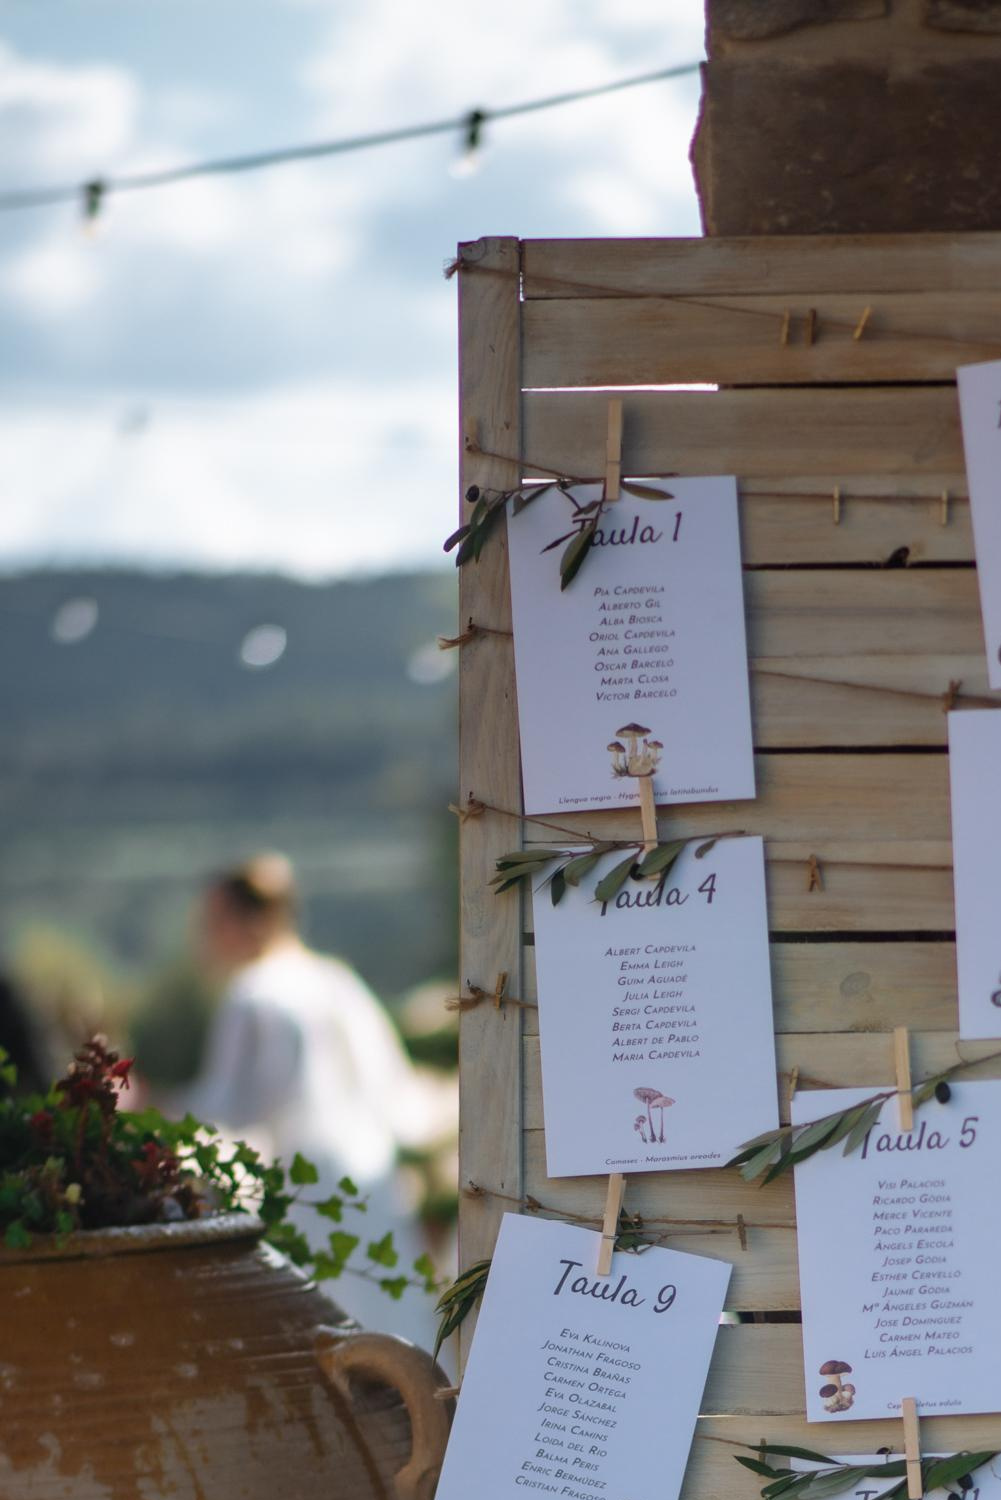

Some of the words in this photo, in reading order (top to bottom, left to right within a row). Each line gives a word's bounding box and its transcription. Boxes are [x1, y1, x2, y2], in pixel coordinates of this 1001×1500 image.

[672, 512, 683, 543] 1
[698, 873, 717, 904] 4
[604, 947, 642, 957] ALBERT
[644, 944, 696, 955] CAPDEVILA
[619, 961, 650, 972] EMMA
[653, 959, 684, 969] LEIGH
[617, 976, 645, 987] GUIM
[622, 991, 649, 1003] JULIA
[653, 989, 684, 1000] LEIGH
[612, 1007, 641, 1017] SERGI
[643, 1005, 696, 1016] CAPDEVILA
[612, 1021, 642, 1033] BERTA
[645, 1019, 698, 1030] CAPDEVILA
[611, 1037, 649, 1048] ALBERT
[651, 1036, 665, 1045] DE
[667, 1033, 700, 1044] PABLO
[612, 1052, 645, 1063] MARIA
[648, 1049, 701, 1061] CAPDEVILA
[861, 1121, 950, 1159] Taula
[959, 1116, 979, 1149] 5
[553, 1259, 646, 1309] Taula
[653, 1283, 677, 1314] 9
[559, 1328, 580, 1341] EVA
[582, 1333, 631, 1353] KALINOVA
[540, 1339, 594, 1360] JONATHAN
[595, 1352, 642, 1372] FRAGOSO
[546, 1356, 590, 1375] CRISTINA
[592, 1367, 632, 1385] BRAÑAS
[543, 1371, 586, 1389] CARMEN
[587, 1382, 627, 1400] ORTEGA
[544, 1387, 565, 1401] EVA
[536, 1401, 571, 1417] JORGE
[540, 1417, 567, 1433] IRINA
[570, 1425, 609, 1443] CAMINS
[534, 1432, 564, 1448] LOIDA
[566, 1442, 585, 1453] DEL
[521, 1460, 553, 1477] ENRIC
[535, 1448, 569, 1465] BALMA
[571, 1457, 600, 1472] PERIS
[515, 1475, 559, 1493] CRISTIAN
